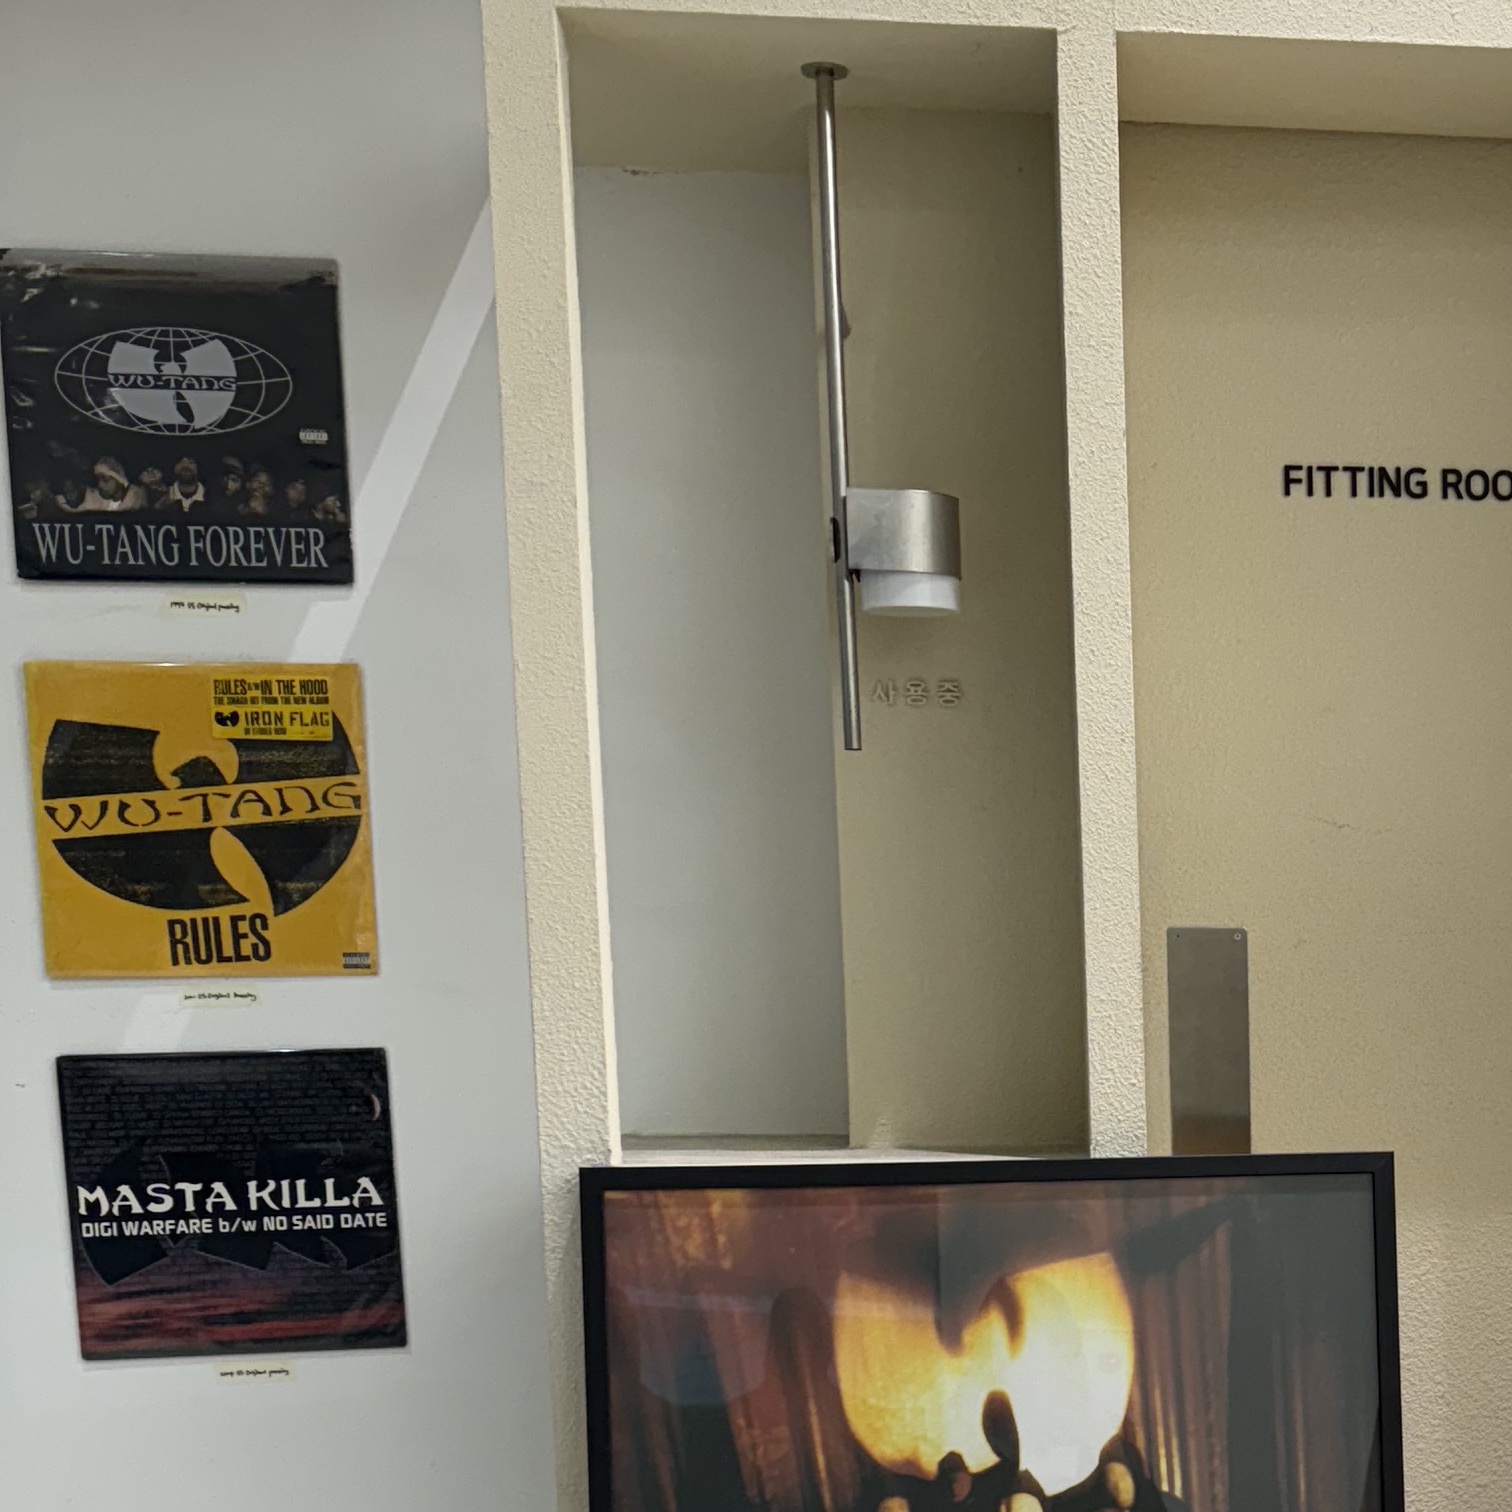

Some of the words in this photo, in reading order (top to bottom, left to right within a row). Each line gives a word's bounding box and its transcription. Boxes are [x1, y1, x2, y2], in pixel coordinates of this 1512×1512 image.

[108, 374, 237, 391] WU-TANG
[1283, 464, 1429, 499] FITTING
[33, 523, 180, 567] WU-TANG
[186, 524, 328, 568] FOREVER
[213, 679, 247, 696] RULES
[261, 679, 273, 696] IN
[275, 679, 296, 696] THE
[299, 679, 328, 695] HOOD
[872, 680, 962, 707] 사용중
[244, 710, 284, 727] IRON
[289, 710, 330, 727] FLAG
[44, 781, 362, 832] WU-TANG
[167, 913, 272, 967] RULES
[77, 1180, 237, 1216] MASTA
[246, 1176, 385, 1211] KILLA
[82, 1221, 118, 1238] DIGI
[122, 1217, 213, 1236] WARFARE
[218, 1216, 257, 1234] b/w
[263, 1215, 288, 1231] NO
[292, 1213, 334, 1230] SAID
[340, 1211, 388, 1229] DATE
